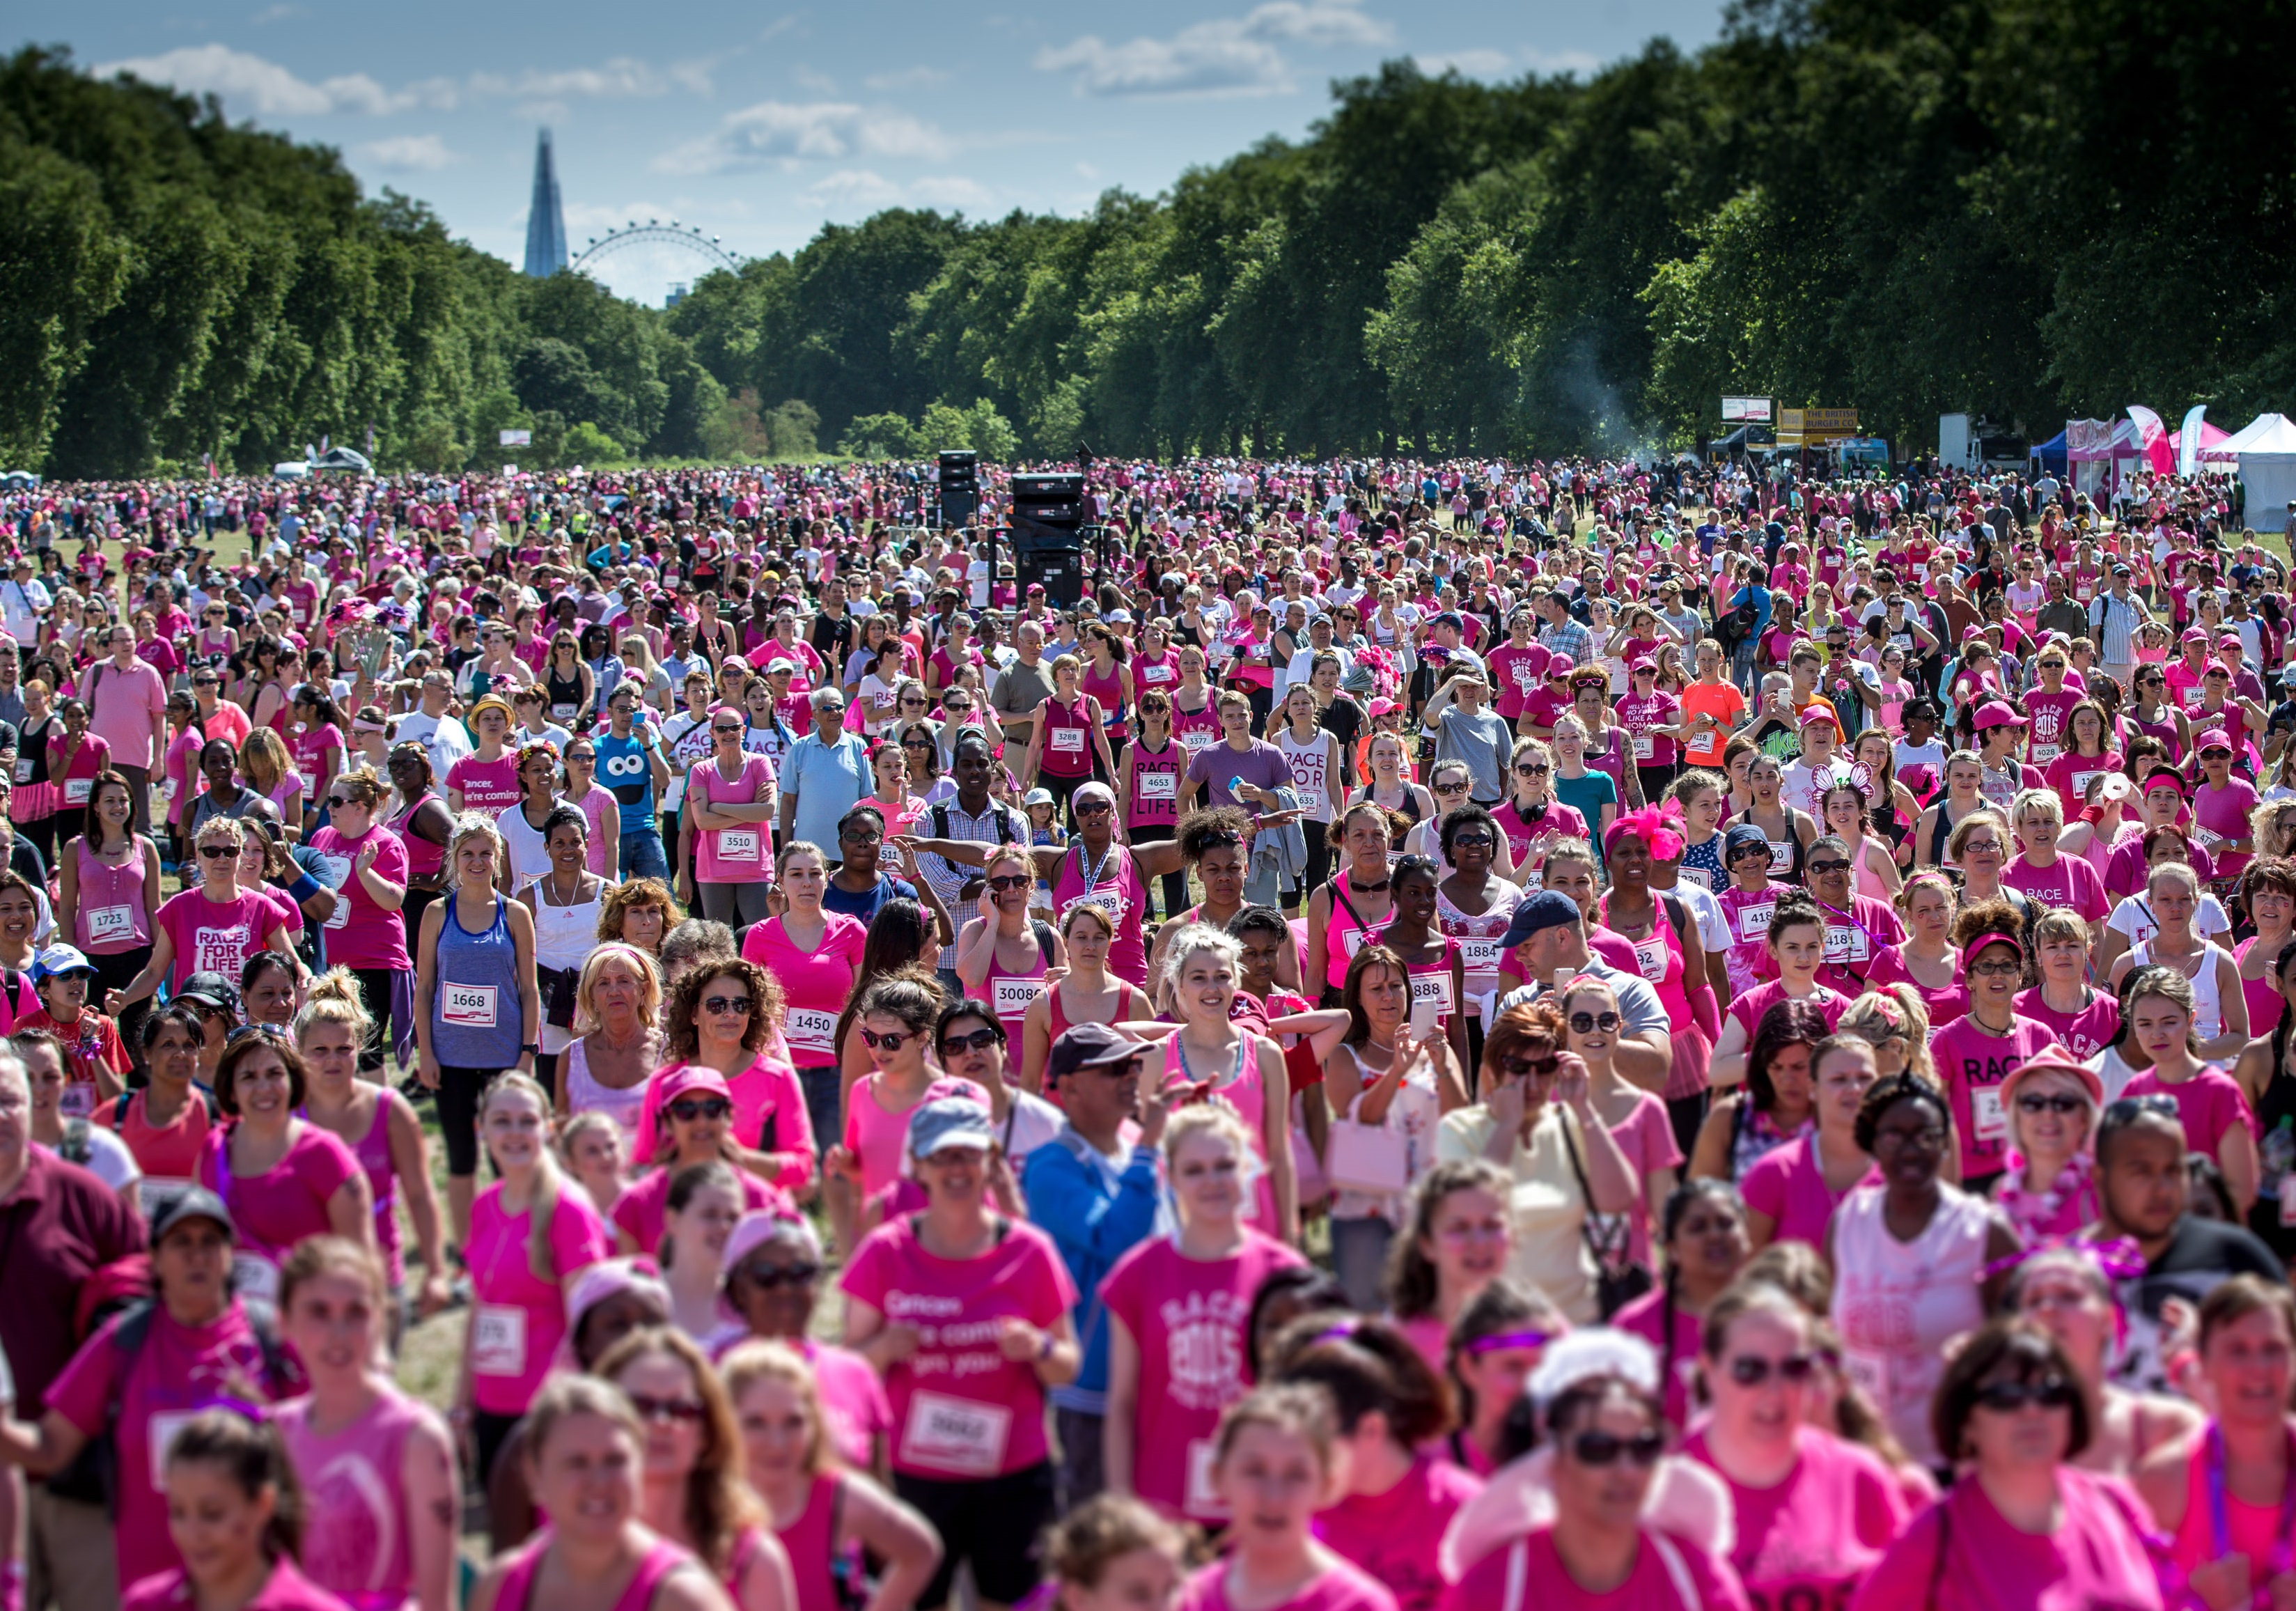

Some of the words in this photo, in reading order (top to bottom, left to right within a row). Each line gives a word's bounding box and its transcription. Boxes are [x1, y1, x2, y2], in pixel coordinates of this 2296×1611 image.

[1806, 419, 1838, 428] BURGER
[1508, 657, 1532, 667] RACE
[1512, 664, 1531, 680] 2015
[2034, 704, 2063, 717] RACE
[2035, 715, 2058, 736] 2015
[2035, 733, 2045, 742] FOR
[1137, 761, 1178, 777] RACE
[1295, 768, 1322, 787] OR
[485, 790, 520, 801] coming
[1137, 798, 1177, 815] LIFE
[727, 838, 750, 846] 3510
[2201, 834, 2216, 845] 477
[1524, 877, 1540, 885] 64
[2026, 888, 2063, 901] RACE
[1091, 897, 1116, 909] 089
[97, 913, 123, 926] 1723
[1751, 911, 1772, 924] 418
[198, 932, 243, 944] RACE
[203, 944, 237, 958] FOR
[1467, 947, 1496, 957] 1884
[203, 958, 240, 972] LIFE
[1637, 952, 1653, 965] 92
[1414, 983, 1440, 997] 888
[453, 993, 485, 1006] 1668
[796, 1015, 830, 1032] 1450
[2059, 1034, 2100, 1058] ACE
[1962, 1054, 2022, 1085] RAC
